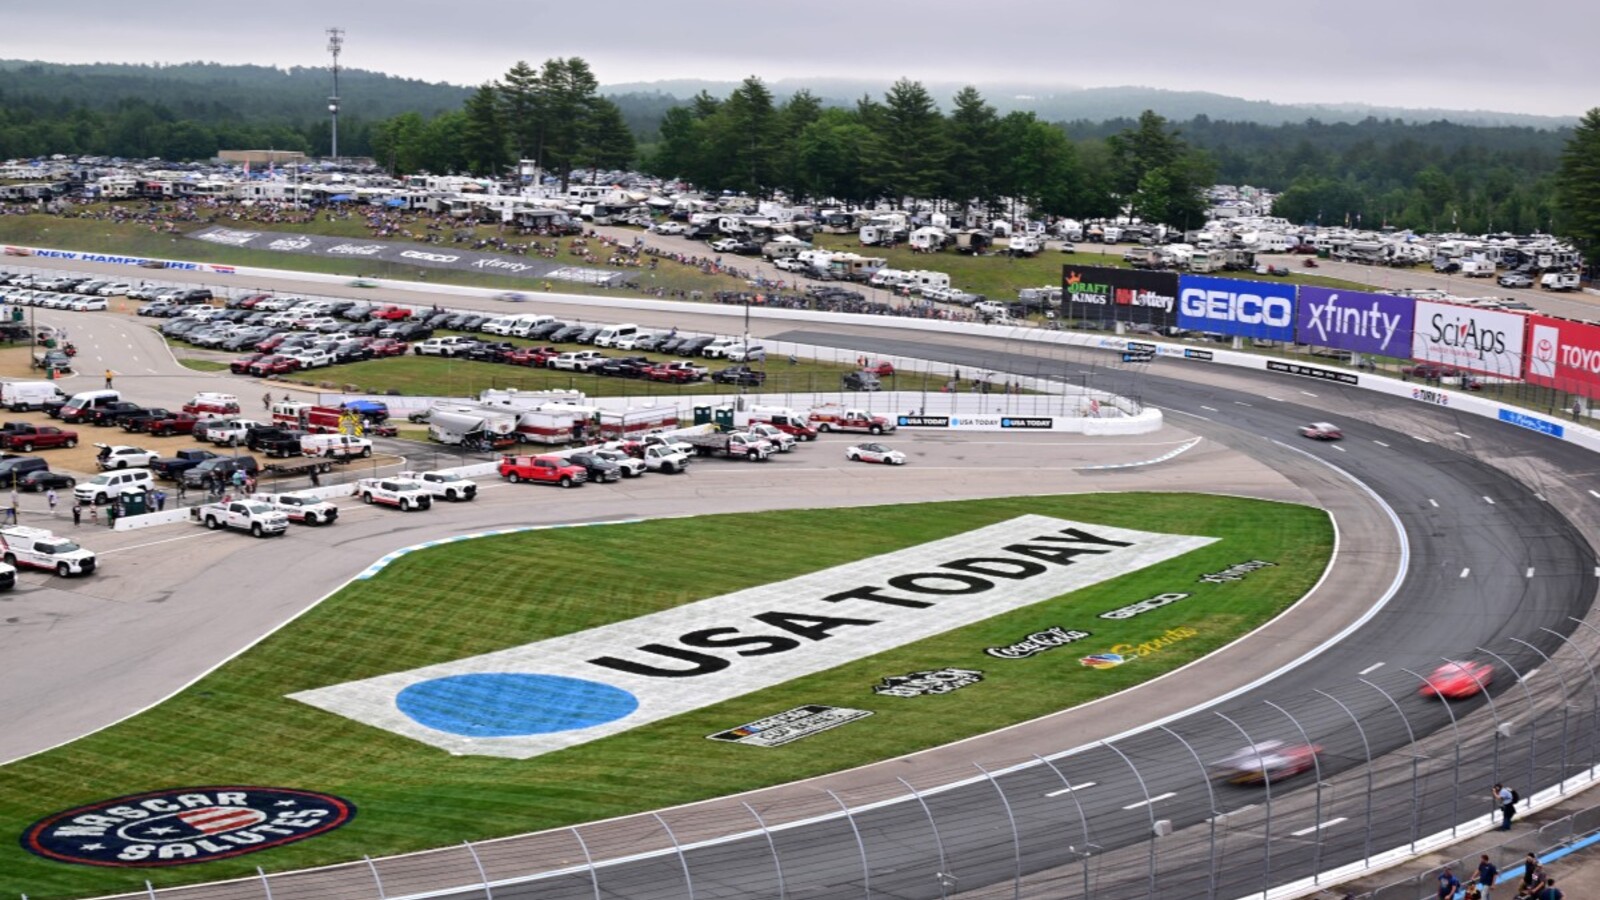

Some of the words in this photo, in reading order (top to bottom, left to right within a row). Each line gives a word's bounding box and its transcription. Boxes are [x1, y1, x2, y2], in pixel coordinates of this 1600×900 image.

[37, 250, 76, 259] NEW
[82, 254, 197, 269] HAMPSIRE
[400, 250, 459, 263] GEICO
[472, 257, 533, 272] xfinity
[1068, 282, 1108, 294] DRAFT
[1072, 293, 1107, 305] KINGS
[1181, 288, 1292, 328] GEICO
[1307, 293, 1401, 350] xfinity
[1430, 313, 1506, 361] SciAps
[1420, 389, 1436, 403] TURN
[588, 612, 879, 678] USA
[823, 528, 1133, 609] TODAY
[1100, 593, 1190, 619] GEICO
[53, 792, 248, 837] NASCAR
[117, 809, 329, 860] SALUTES
